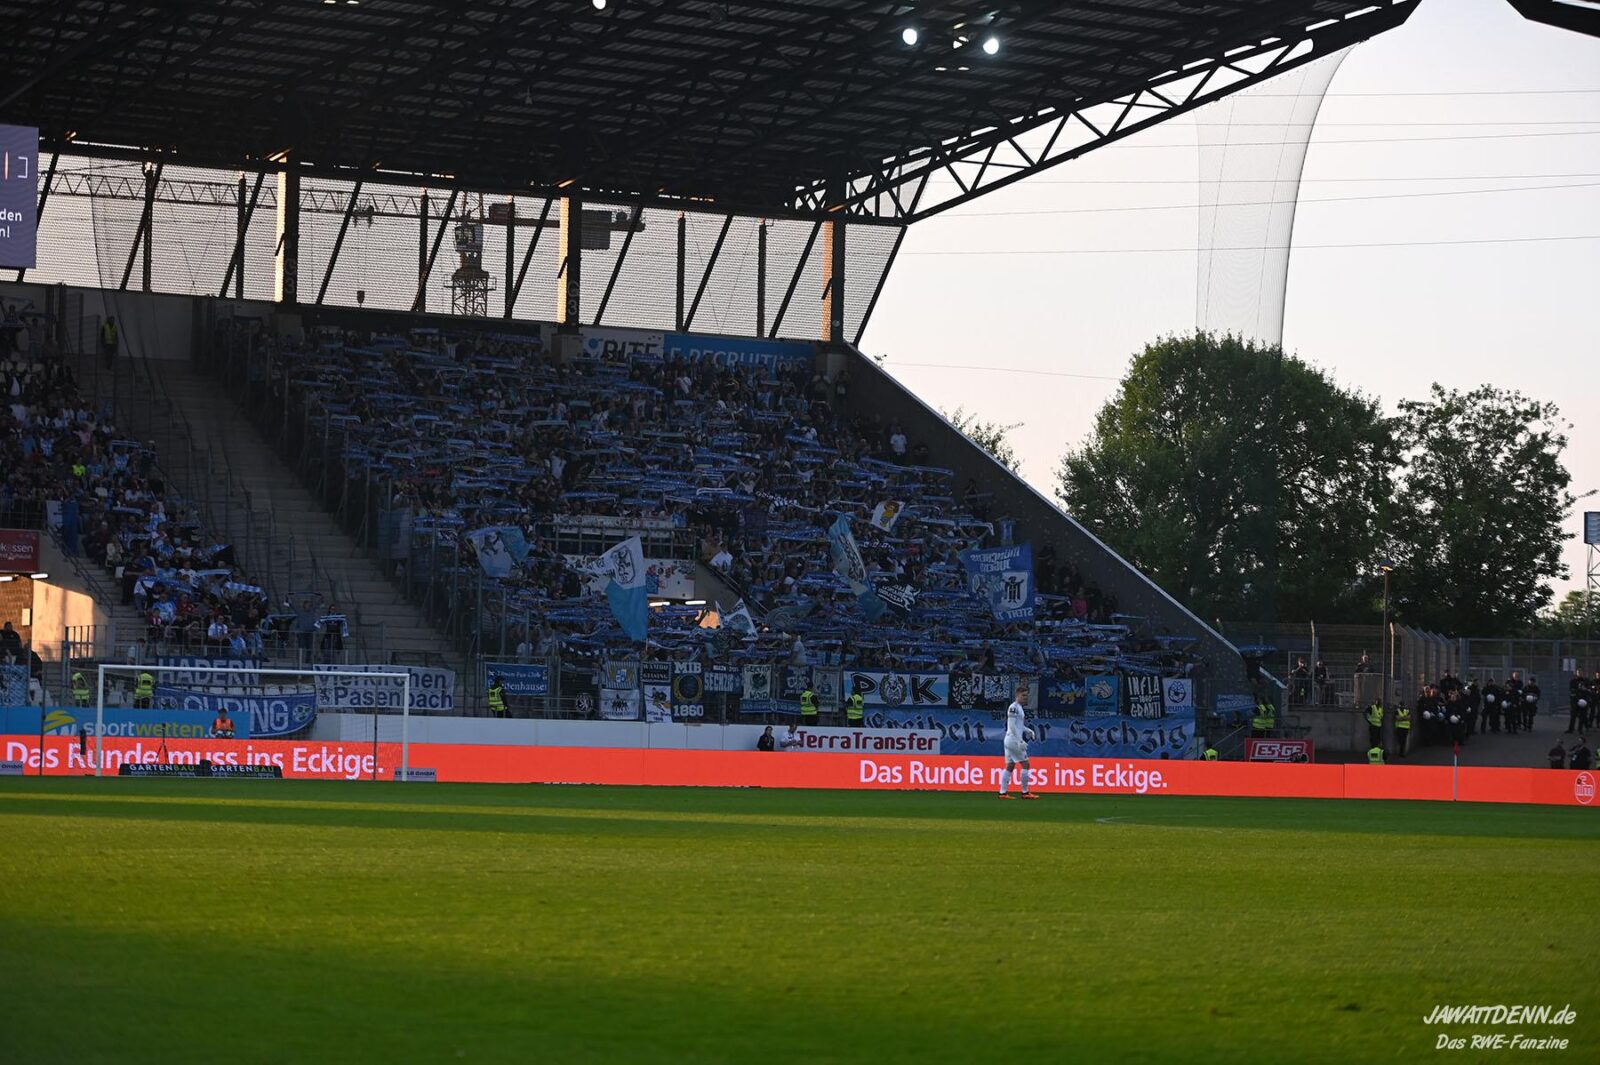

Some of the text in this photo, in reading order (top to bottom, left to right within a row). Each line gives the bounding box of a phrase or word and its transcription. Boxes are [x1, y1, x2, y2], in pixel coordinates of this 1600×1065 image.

[158, 658, 261, 685] HADERN
[673, 704, 705, 717] 1860
[798, 731, 938, 750] TerraTransfer
[7, 742, 59, 768] Das
[68, 743, 159, 769] Runde
[247, 745, 283, 770] ins
[129, 764, 195, 772] GARTENBAU
[211, 765, 275, 773] GARTENBAU
[860, 760, 902, 783] Das
[910, 761, 984, 785] Runde
[1055, 763, 1086, 787] ins
[1092, 764, 1168, 793] Eckige.
